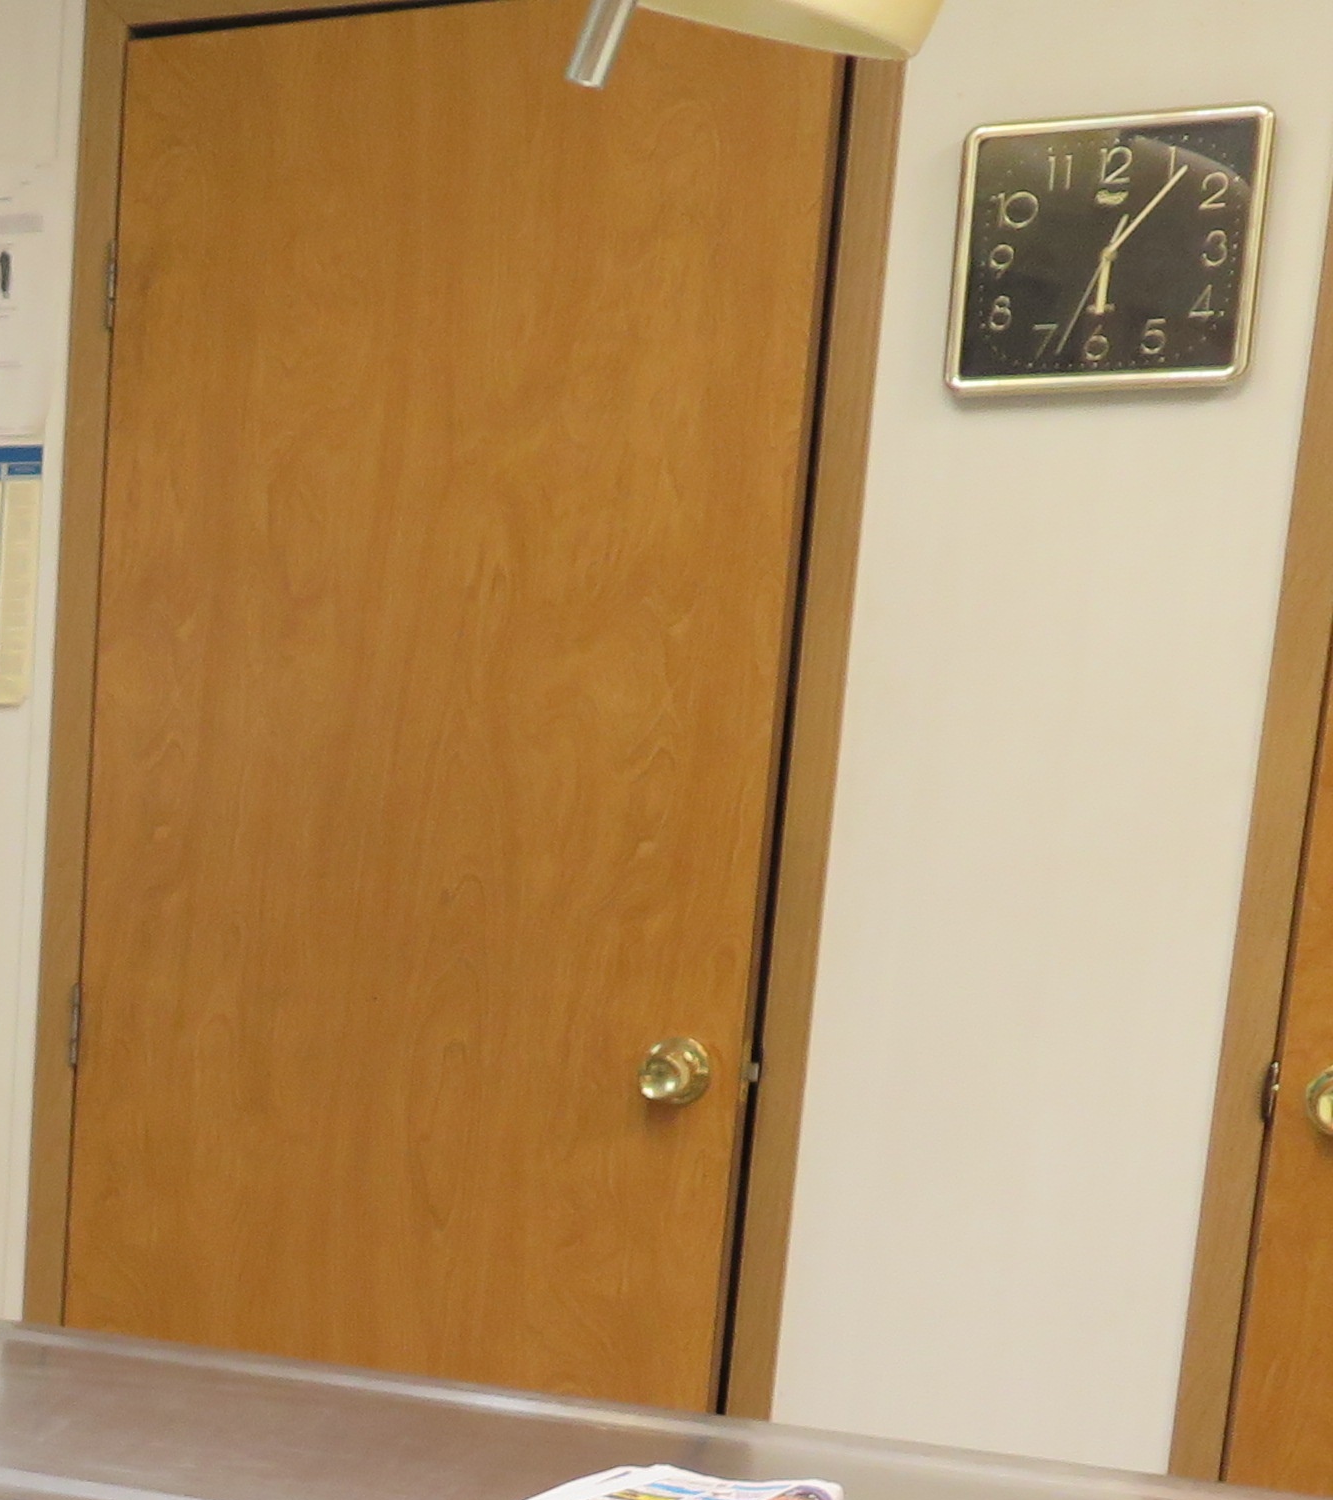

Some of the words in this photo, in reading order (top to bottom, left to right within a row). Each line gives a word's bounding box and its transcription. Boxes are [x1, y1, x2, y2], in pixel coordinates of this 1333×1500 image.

[1047, 154, 1073, 191] 11
[1100, 146, 1133, 185] 12
[990, 190, 1039, 229] 10
[1199, 171, 1230, 211] 2
[990, 244, 1015, 279] 9
[1201, 229, 1228, 268] 3
[989, 295, 1012, 331] 8
[1188, 285, 1215, 317] 4
[1032, 323, 1059, 360] 7
[1083, 325, 1110, 361] 6
[1140, 318, 1167, 355] 5
